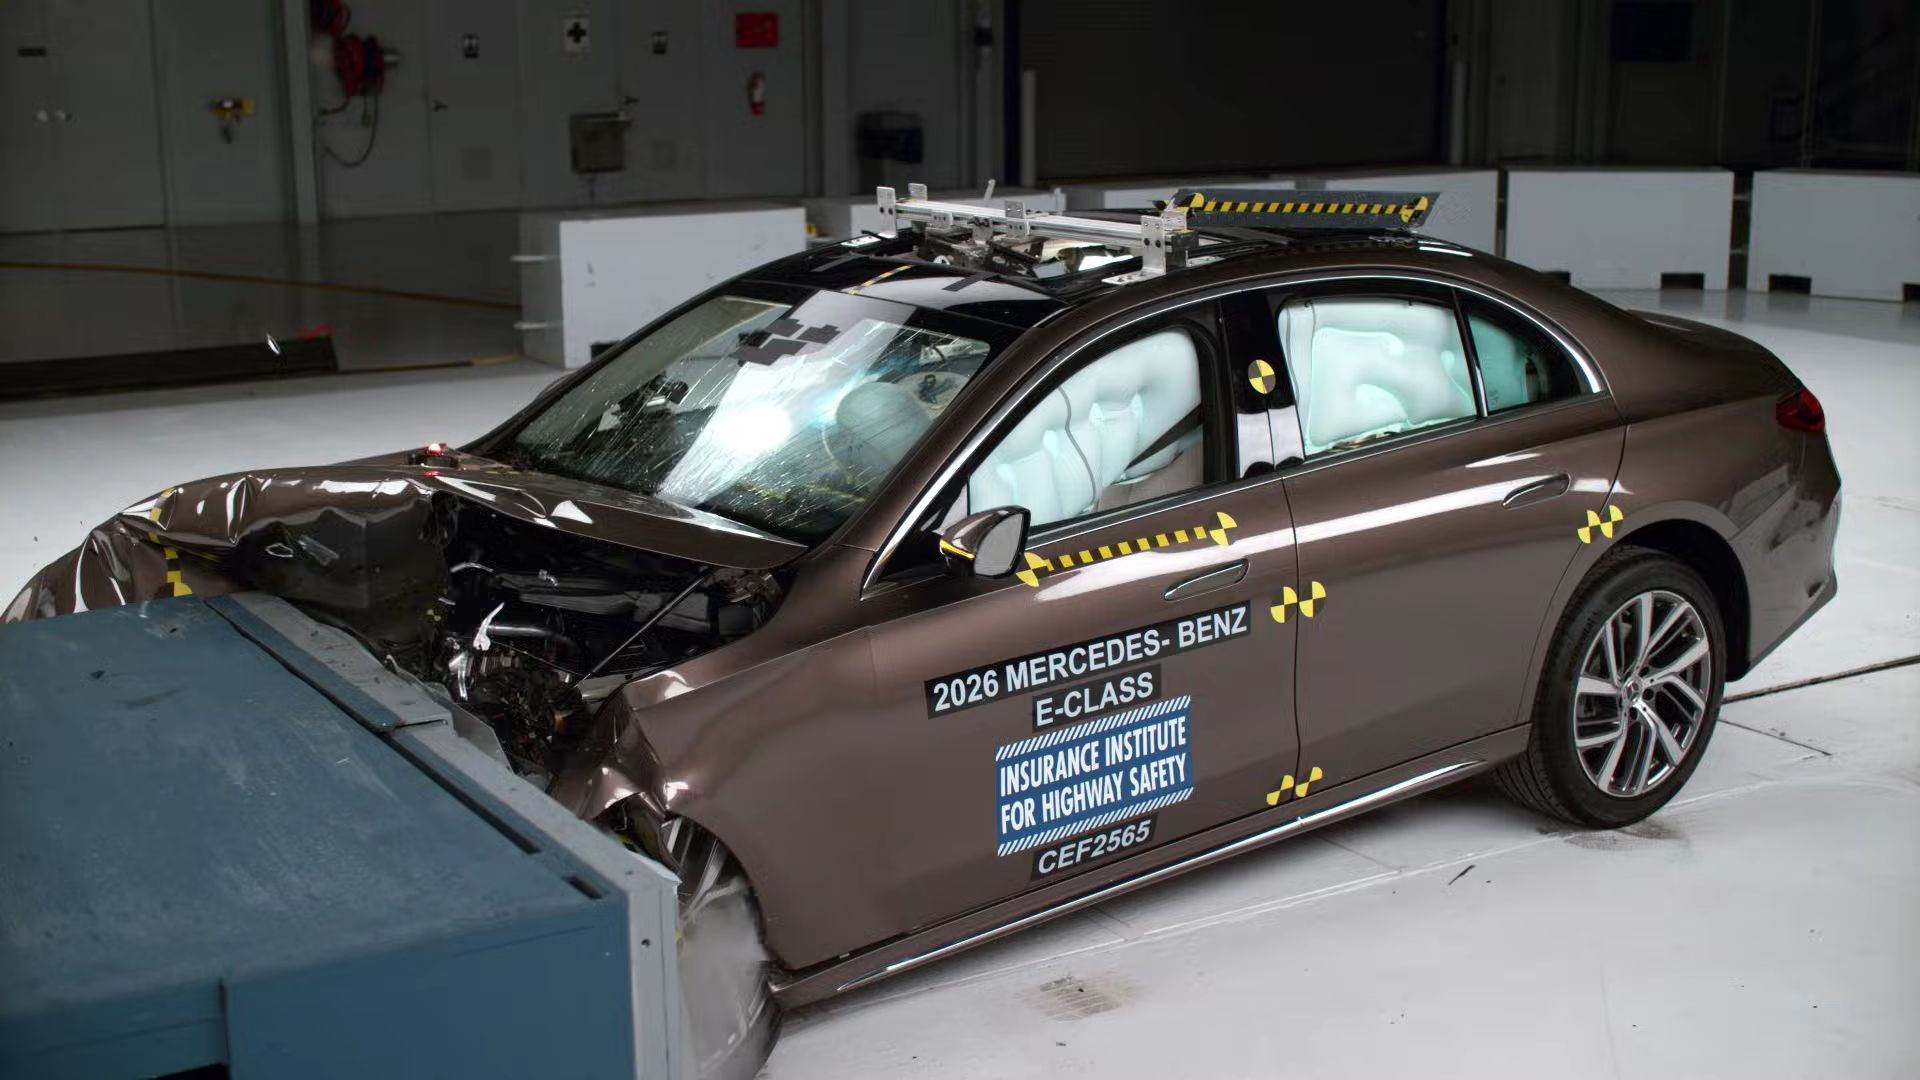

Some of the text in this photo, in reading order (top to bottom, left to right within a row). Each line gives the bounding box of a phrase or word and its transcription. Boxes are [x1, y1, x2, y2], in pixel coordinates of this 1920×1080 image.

[934, 607, 1247, 711] 2026 MERCEDES- BENZ
[1037, 672, 1153, 726] E-CLASS
[1001, 716, 1186, 797] INSURANCE INSTITUTE
[1002, 753, 1186, 834] FOR HIGHWAY SAFETY
[1039, 820, 1150, 873] CEF2565
